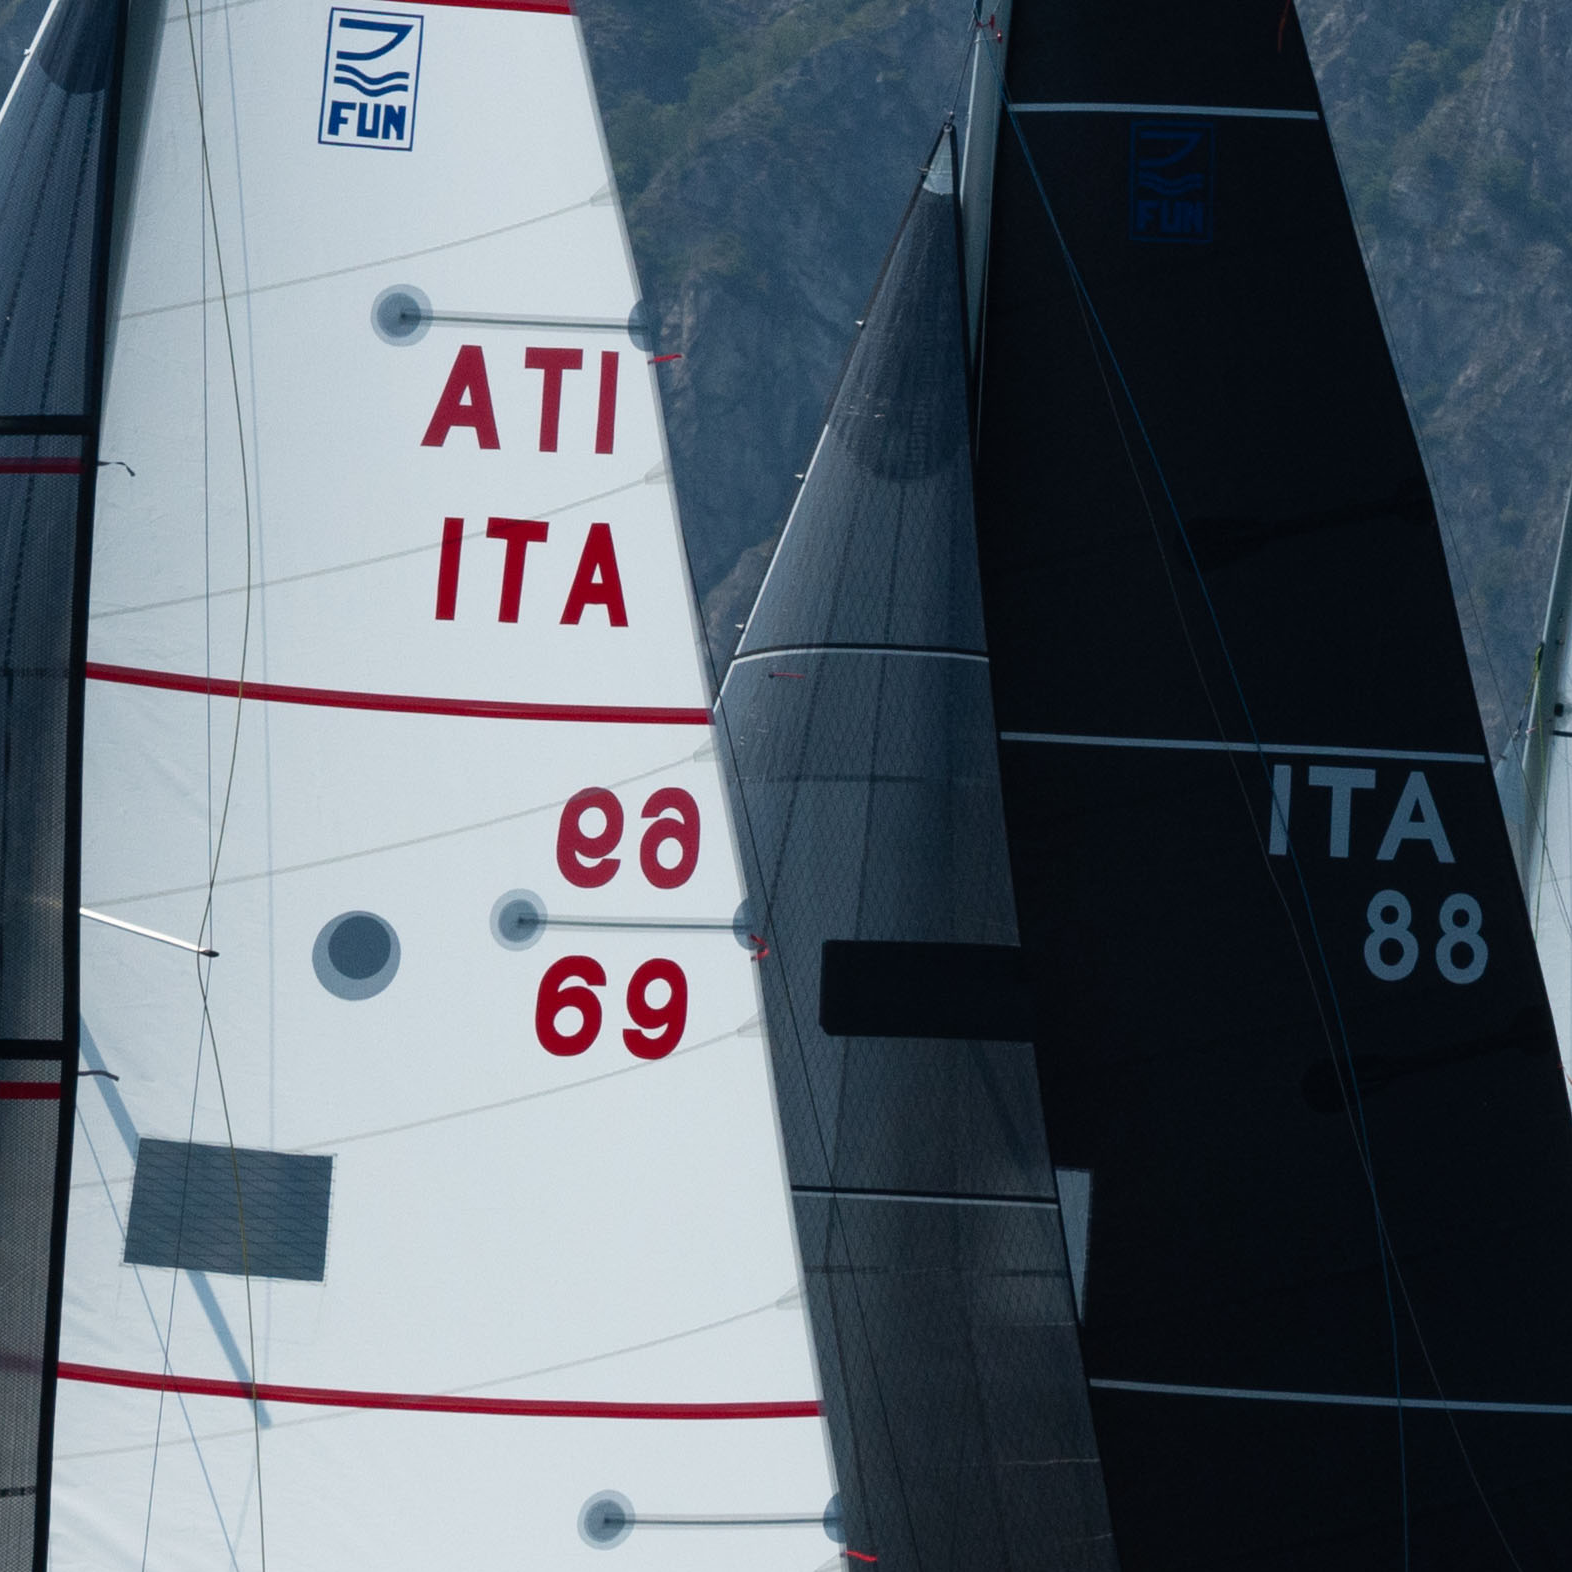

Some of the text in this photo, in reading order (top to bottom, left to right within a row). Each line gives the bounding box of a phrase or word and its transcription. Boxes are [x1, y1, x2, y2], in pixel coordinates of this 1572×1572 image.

[328, 100, 407, 141] FUN
[1137, 199, 1205, 235] FUN
[435, 517, 629, 628] ITA
[1268, 764, 1456, 864] ITA
[1364, 889, 1489, 985] 88
[535, 955, 689, 1061] 69
